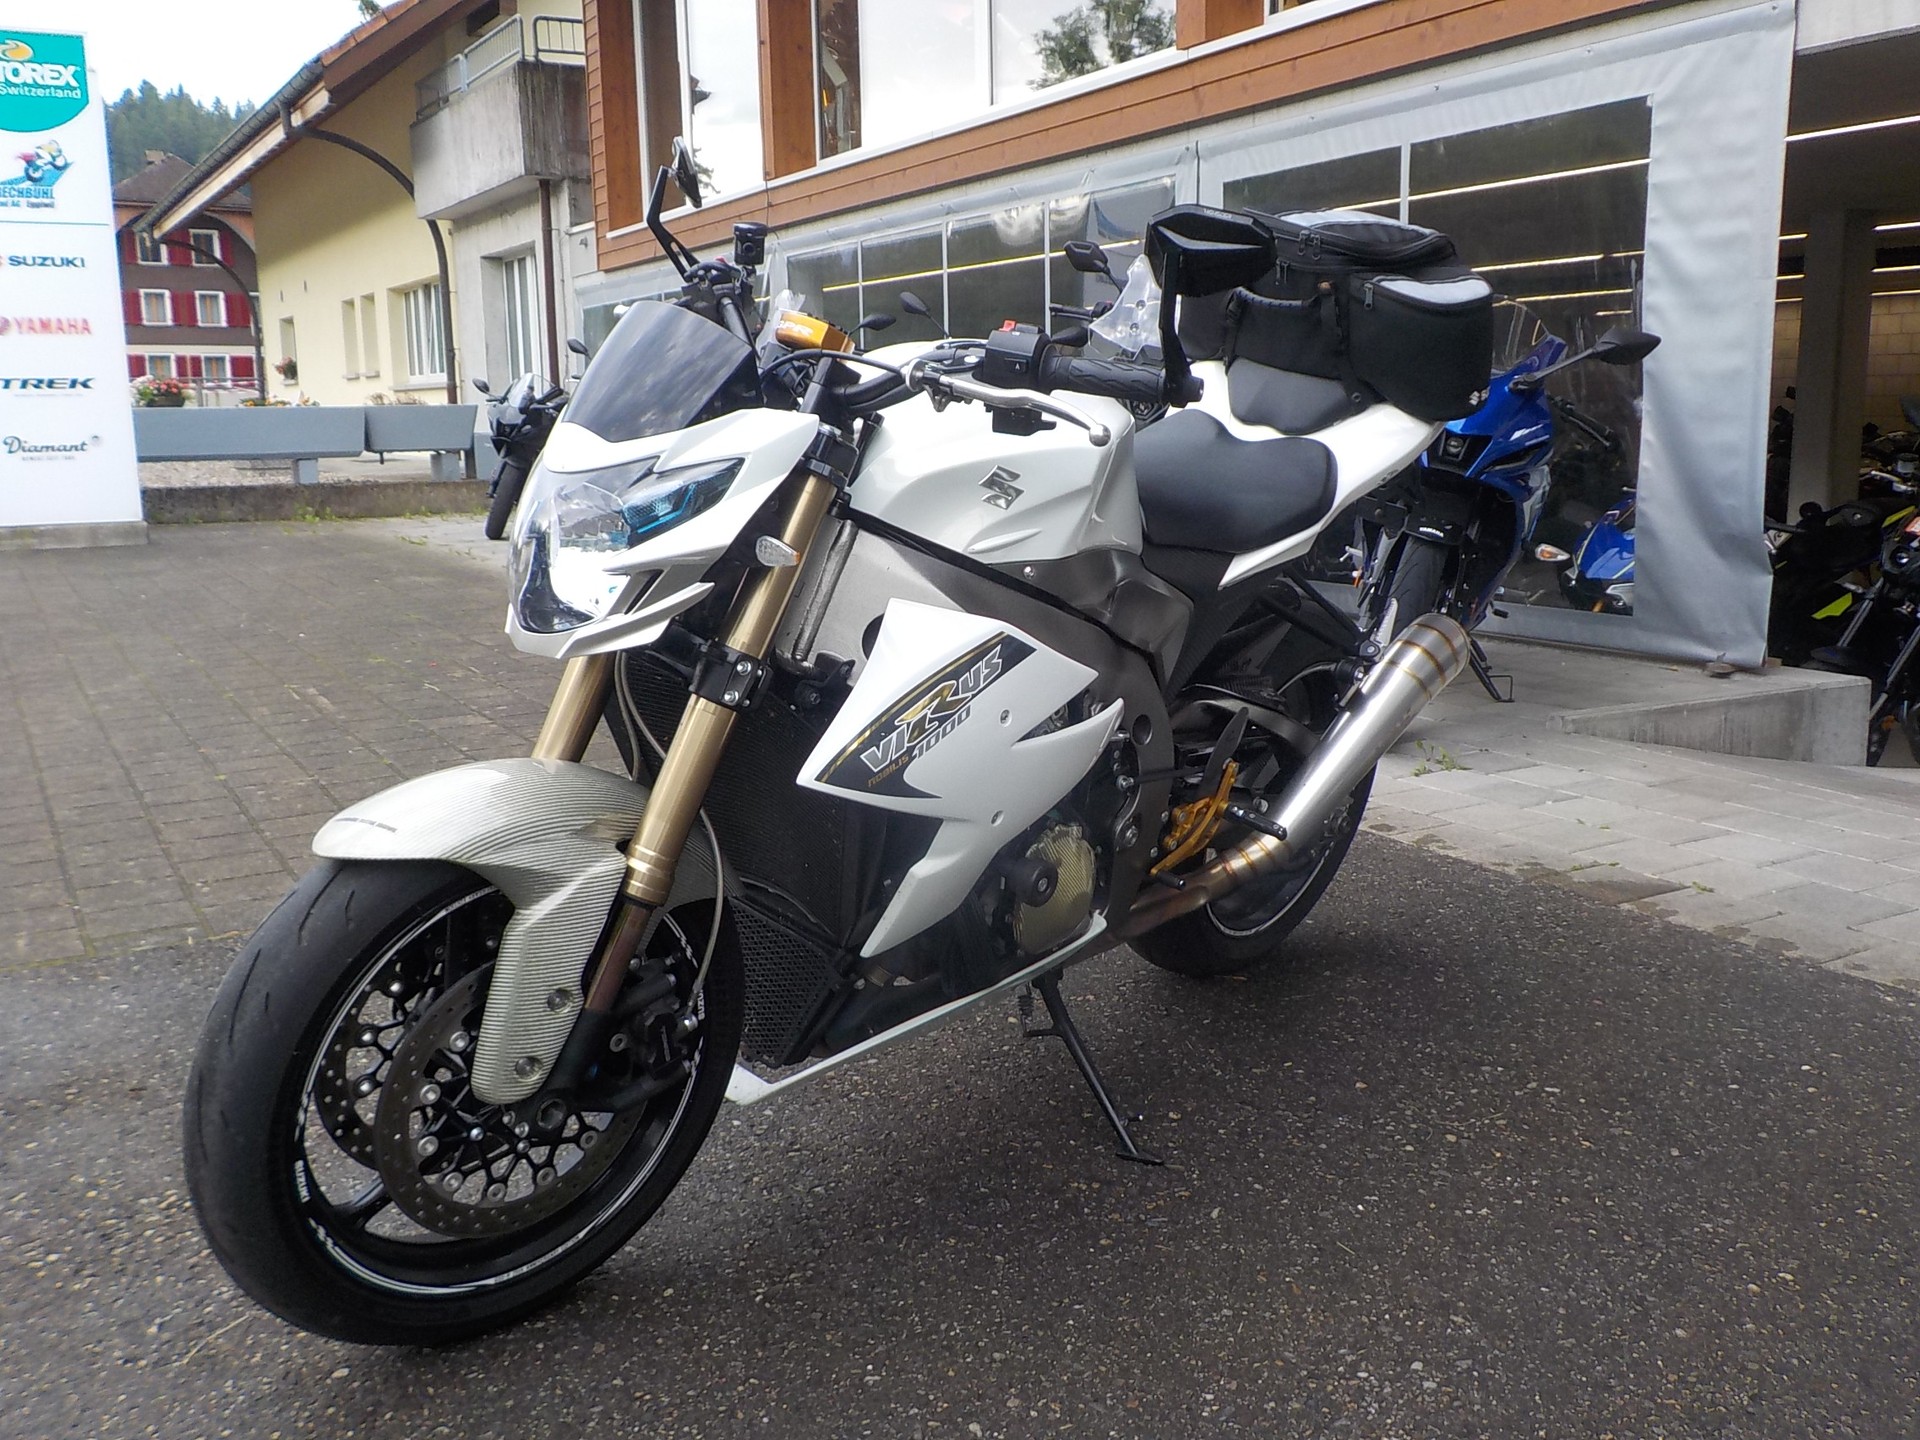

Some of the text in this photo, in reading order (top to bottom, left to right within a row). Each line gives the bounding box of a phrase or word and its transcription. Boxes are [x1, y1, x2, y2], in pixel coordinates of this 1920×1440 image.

[8, 255, 86, 268] SUZUKI
[14, 317, 92, 335] YAMAHA
[0, 377, 95, 390] TREK
[3, 435, 88, 454] Diamant
[860, 644, 1002, 773] VIRUS
[911, 704, 972, 759] 1000
